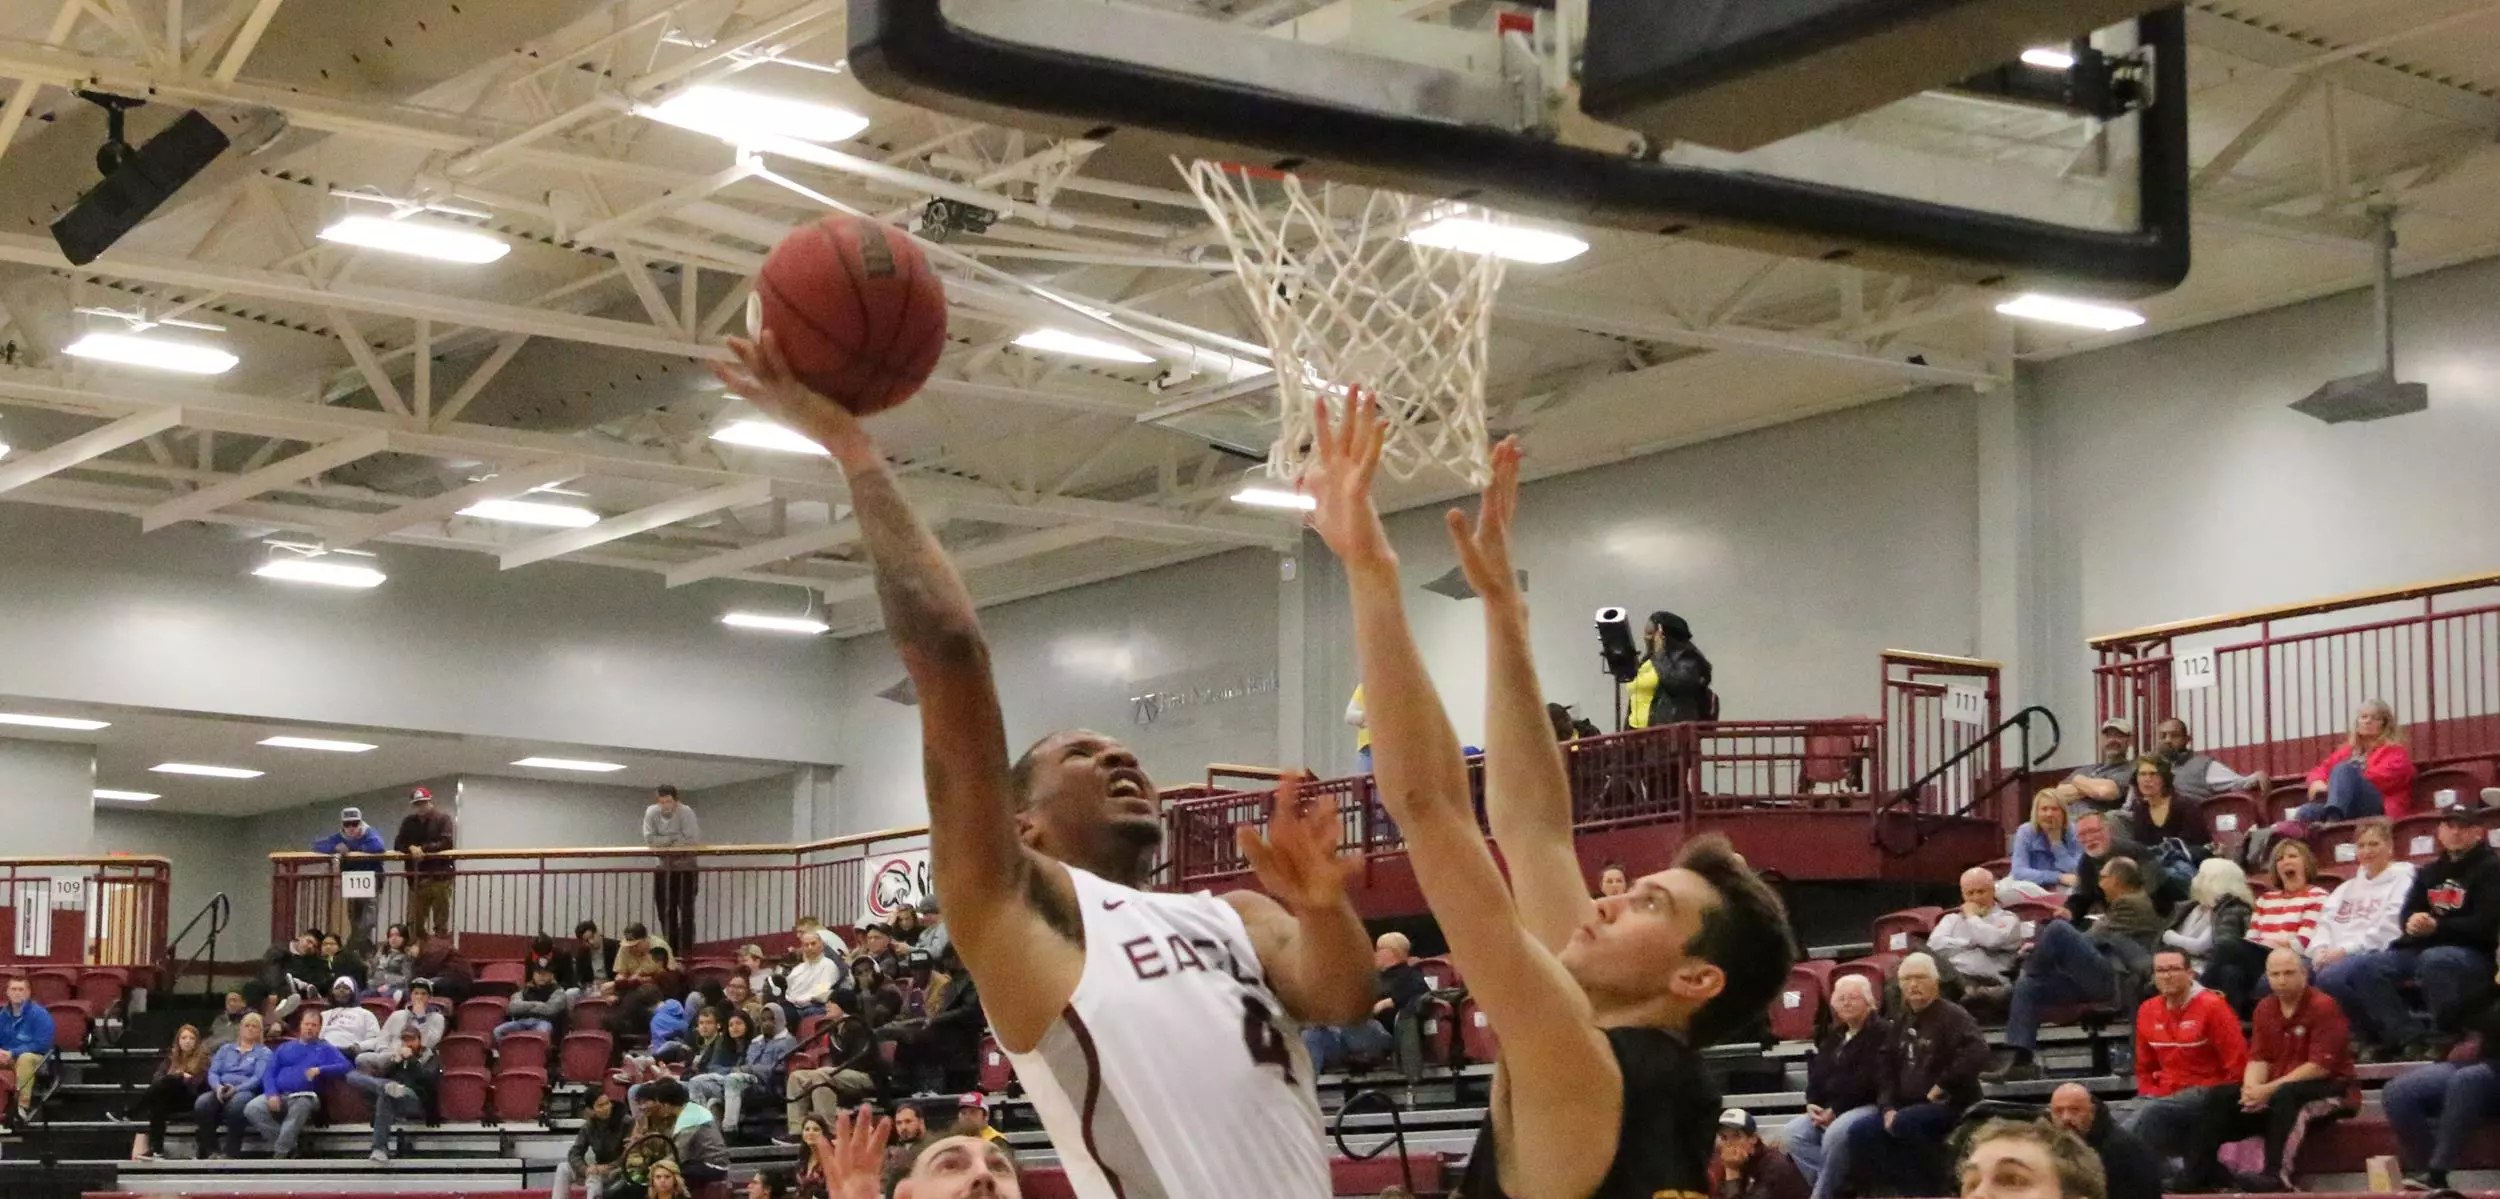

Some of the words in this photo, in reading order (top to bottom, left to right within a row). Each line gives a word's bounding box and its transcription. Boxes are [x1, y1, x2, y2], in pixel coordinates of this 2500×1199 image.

[2183, 656, 2210, 676] 112
[1956, 692, 1977, 711] 111
[57, 881, 80, 893] 109
[350, 877, 371, 889] 110
[1241, 995, 1300, 1086] 4
